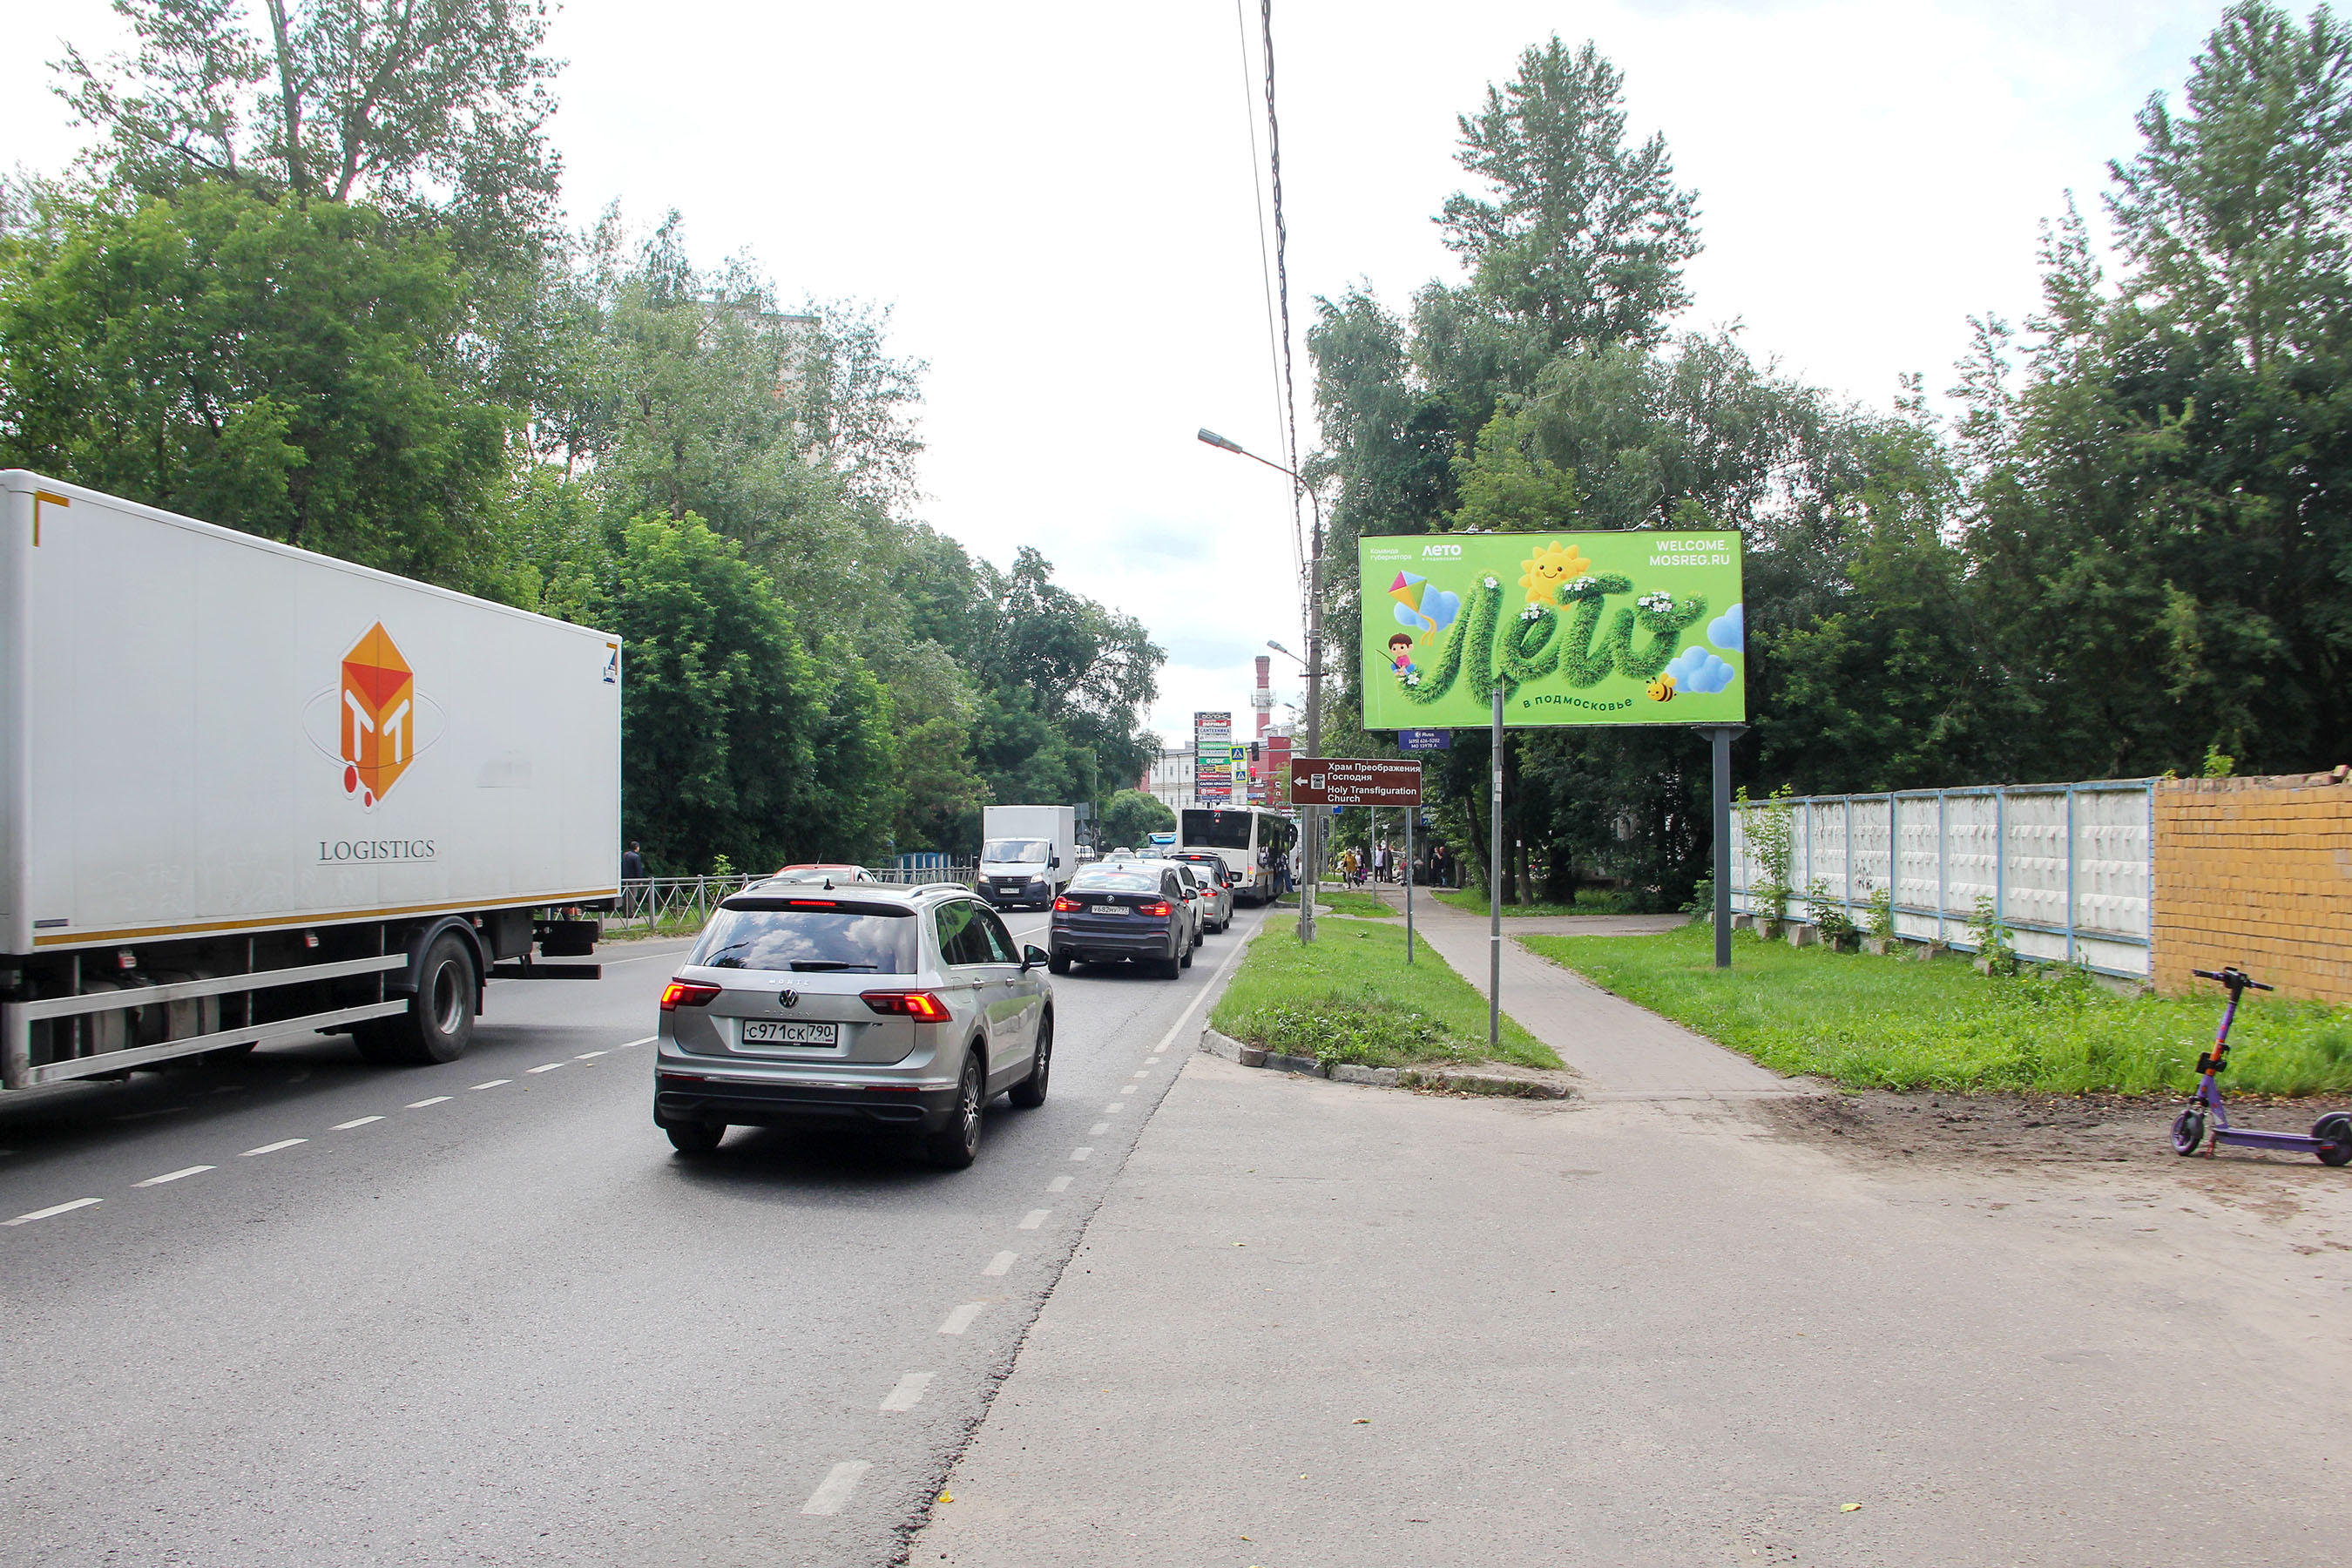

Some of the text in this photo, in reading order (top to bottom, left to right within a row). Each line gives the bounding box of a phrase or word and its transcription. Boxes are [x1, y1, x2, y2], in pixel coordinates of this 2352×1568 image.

[1656, 540, 1729, 551] WELCOME.
[1649, 554, 1730, 566] MOSREG.RU
[1328, 762, 1421, 773] Храм Преображения
[1328, 773, 1373, 781] Господня
[1328, 786, 1417, 796] Holy Transfiguration
[1328, 794, 1361, 802] Church
[320, 840, 436, 861] LOGISTICS
